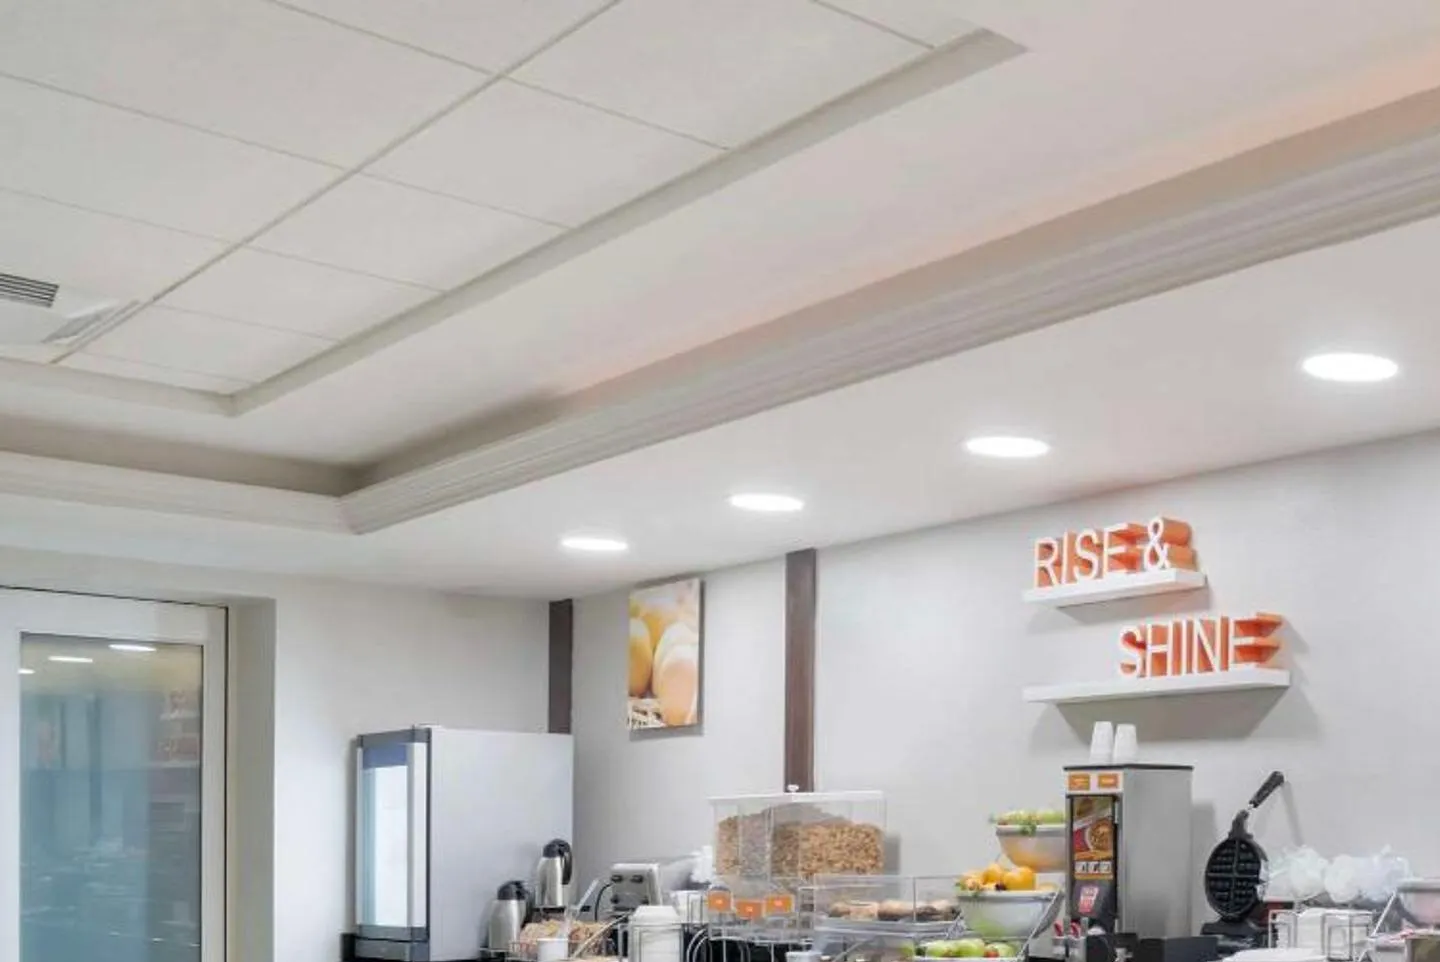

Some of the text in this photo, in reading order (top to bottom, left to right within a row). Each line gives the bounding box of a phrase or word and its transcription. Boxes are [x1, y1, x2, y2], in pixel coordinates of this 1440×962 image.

[1034, 516, 1182, 588] RISE &
[1119, 613, 1266, 679] SHINE
